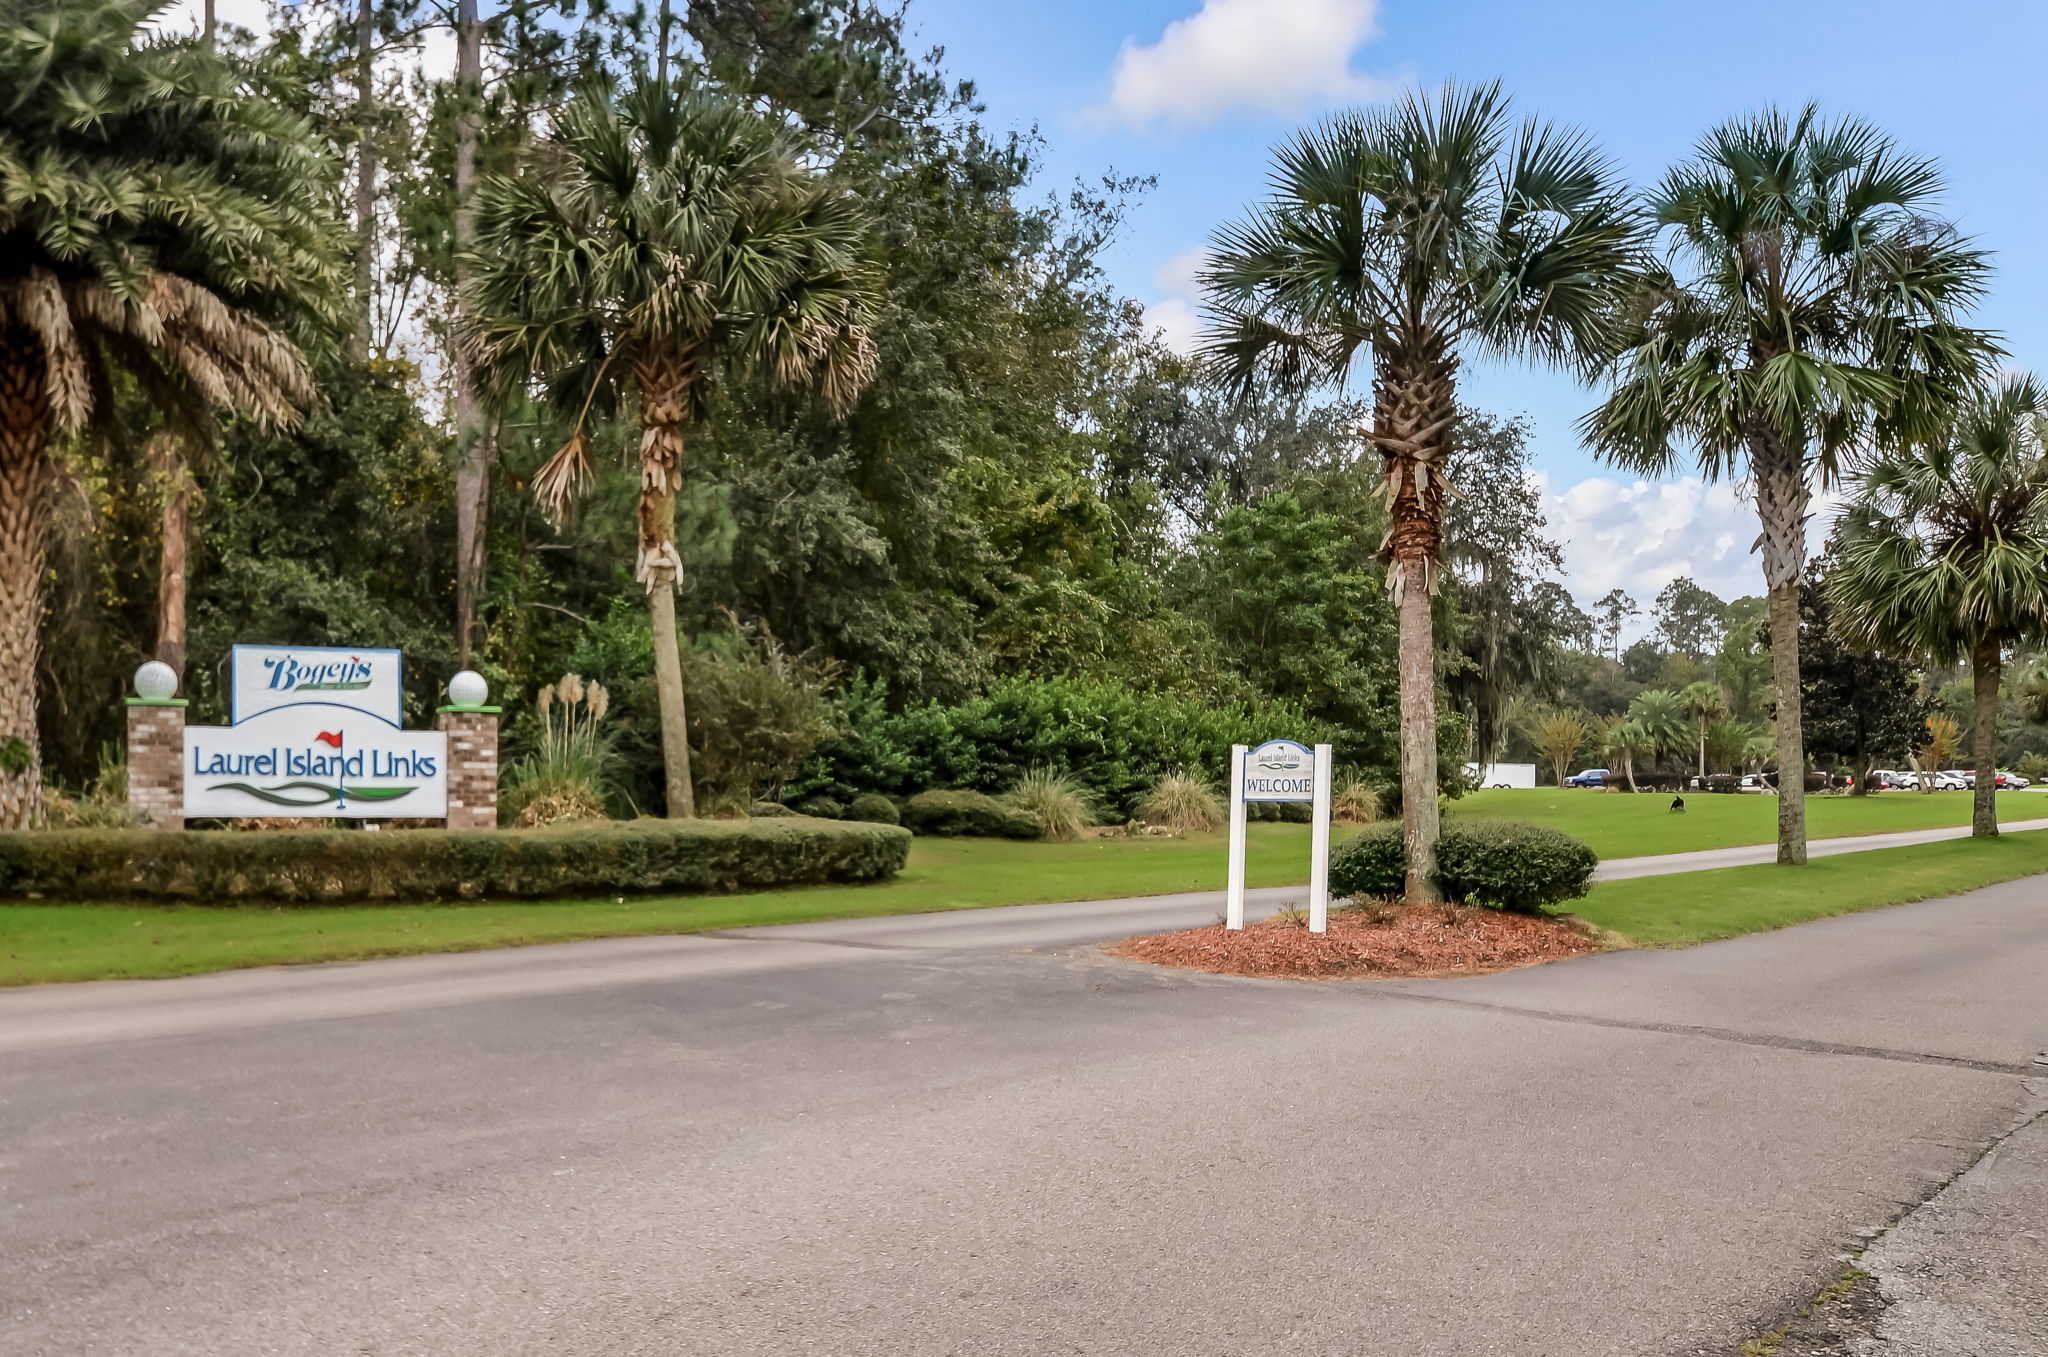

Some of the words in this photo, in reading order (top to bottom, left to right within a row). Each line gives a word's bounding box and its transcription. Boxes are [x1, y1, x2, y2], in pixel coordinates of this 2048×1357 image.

[264, 655, 372, 691] Bogey's
[194, 746, 277, 776] Laurel
[285, 748, 363, 777] Island
[372, 749, 437, 777] Links
[1247, 779, 1311, 793] WELCOME
